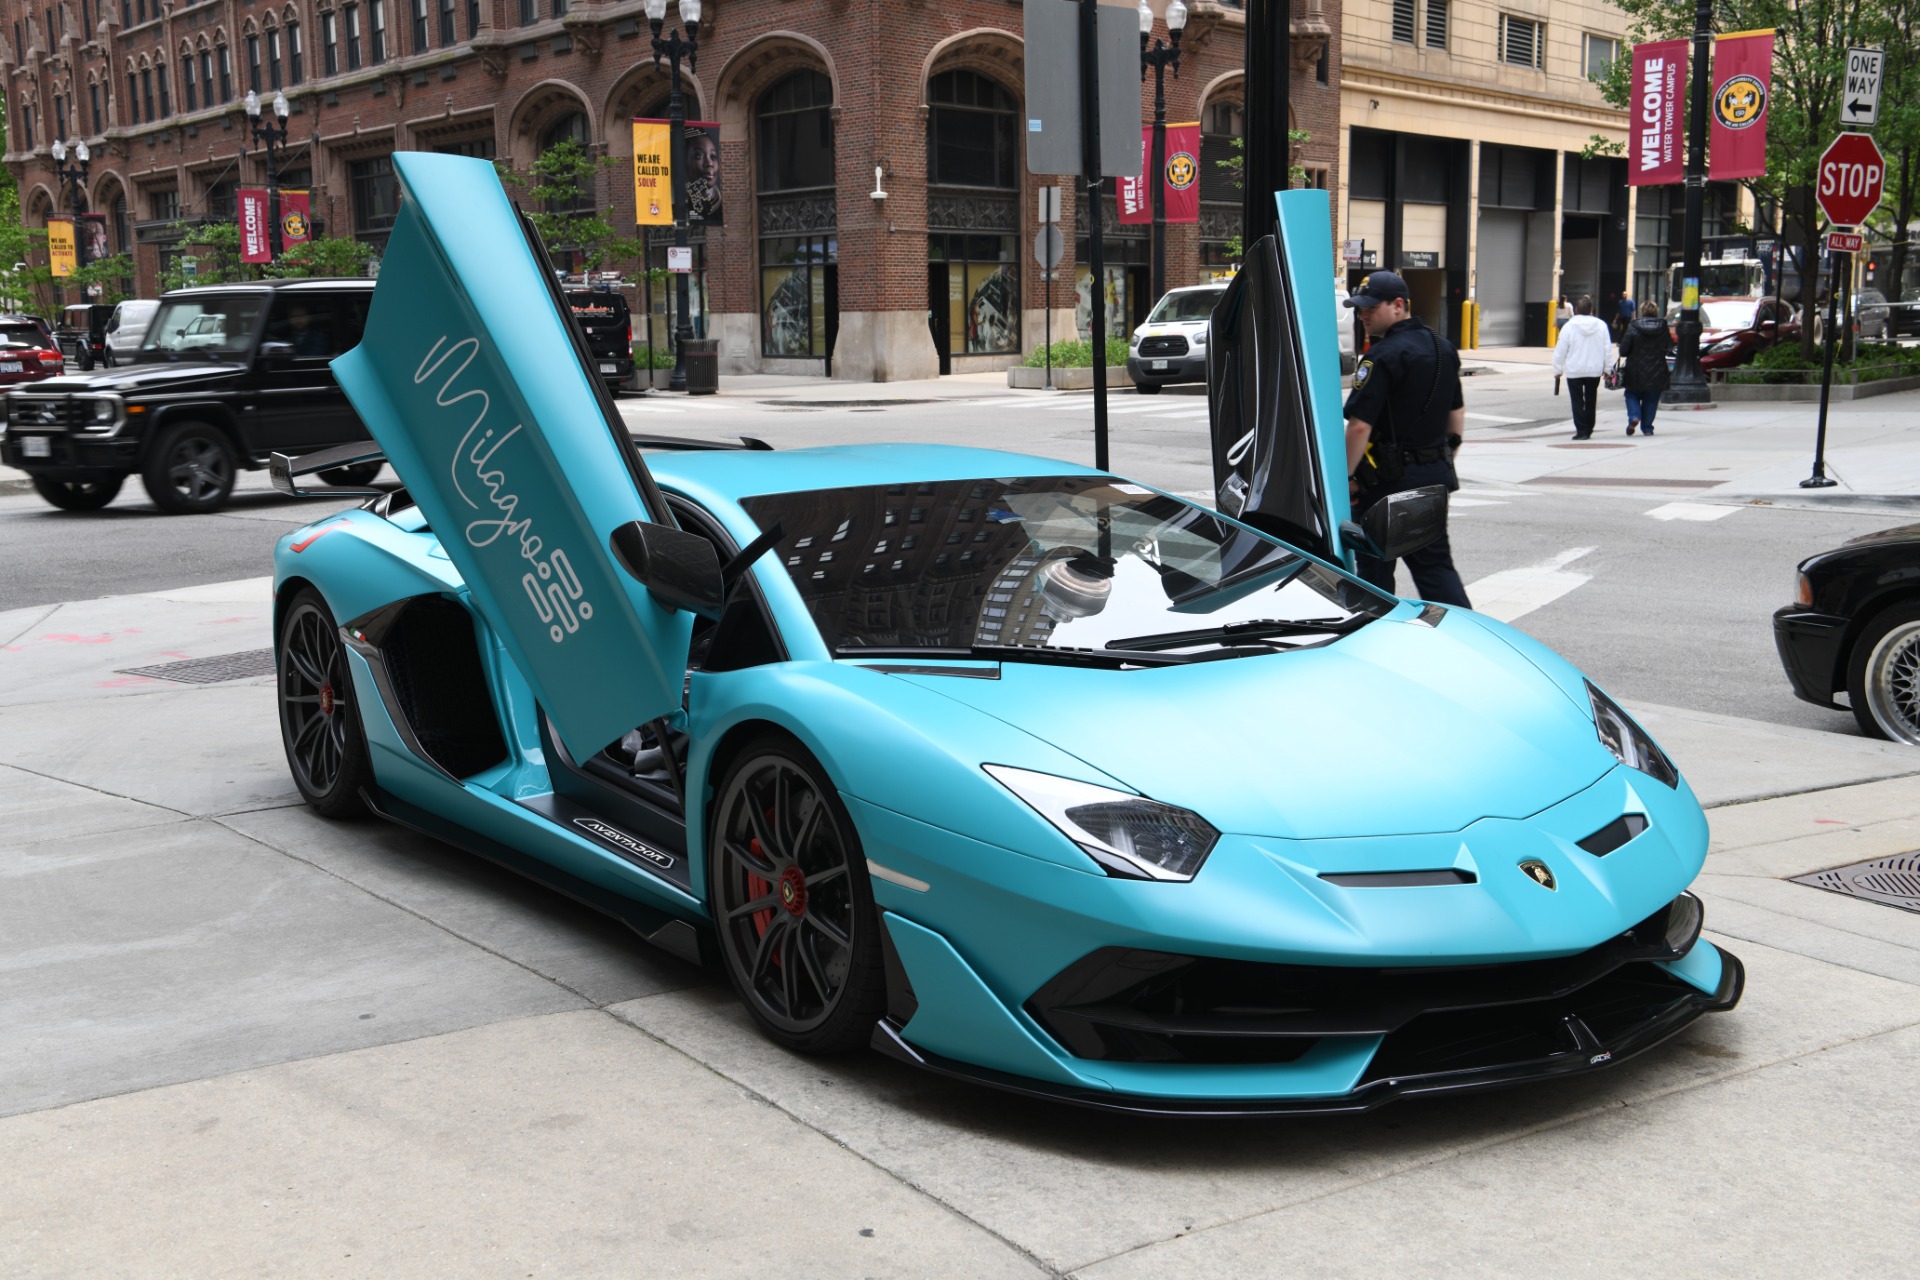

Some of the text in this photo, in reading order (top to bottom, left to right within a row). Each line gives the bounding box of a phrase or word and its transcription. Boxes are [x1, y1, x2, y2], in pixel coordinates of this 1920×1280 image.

[1851, 55, 1878, 74] ONE
[1848, 76, 1876, 95] WAY
[1641, 58, 1663, 171] WELCOME
[1664, 63, 1676, 163] WATER TOWER CAMPUS
[637, 154, 660, 164] WE ARE
[637, 166, 669, 176] CALLED TO
[1822, 162, 1880, 198] STOP
[638, 178, 657, 187] SOLVE
[244, 197, 258, 256] WELCOME
[1831, 236, 1860, 249] ALL WAY
[588, 823, 665, 861] AVENTADOR
